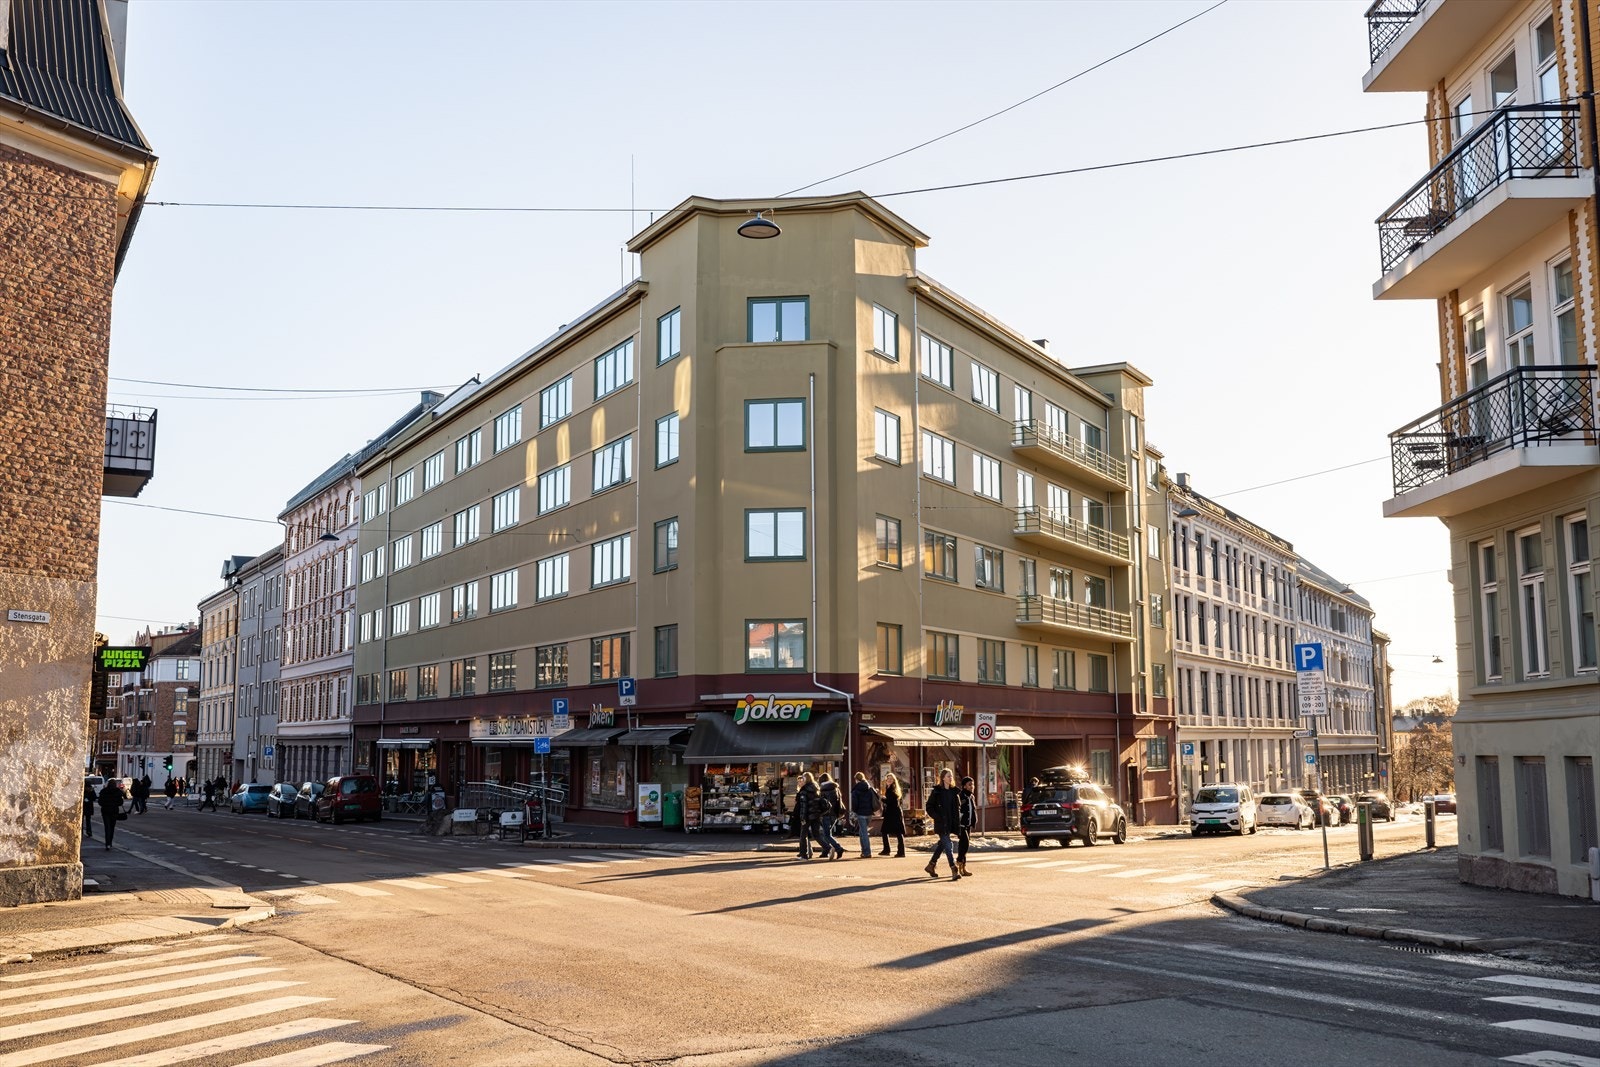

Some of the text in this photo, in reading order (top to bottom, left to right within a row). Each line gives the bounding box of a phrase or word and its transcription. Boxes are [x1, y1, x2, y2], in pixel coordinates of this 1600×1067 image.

[13, 612, 46, 621] Stensgata
[101, 650, 145, 659] JUNGEL
[1301, 647, 1316, 668] P
[104, 659, 141, 667] PIZZA
[622, 680, 631, 694] P
[556, 701, 564, 713] P
[736, 693, 807, 726] joker
[979, 713, 993, 721] Sone
[513, 719, 547, 735] ADAMSTUEN
[980, 727, 990, 737] 30
[266, 747, 272, 755] P
[1184, 744, 1191, 754] P
